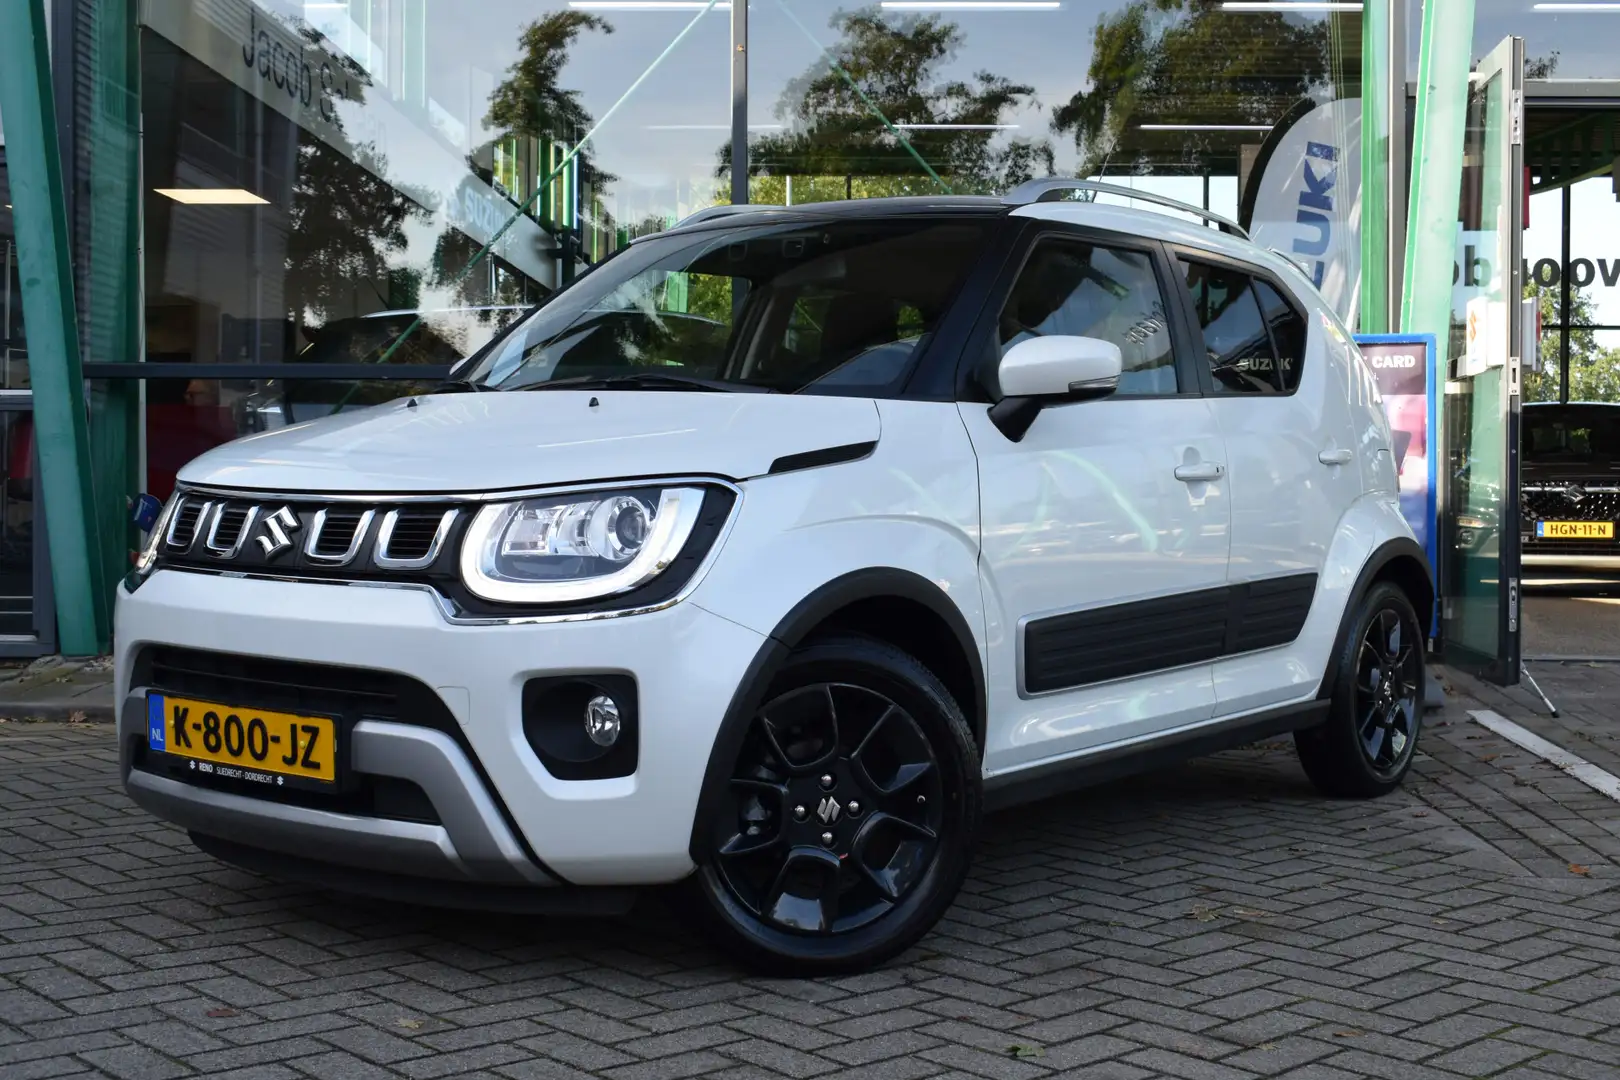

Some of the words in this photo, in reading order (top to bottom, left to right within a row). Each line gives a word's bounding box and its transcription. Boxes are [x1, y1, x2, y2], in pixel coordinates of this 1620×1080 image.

[243, 6, 311, 107] Jacob
[1372, 355, 1416, 368] CARD
[1550, 524, 1606, 535] HGN-11-N
[151, 727, 164, 742] NL
[173, 705, 321, 770] K-800-JZ
[199, 762, 214, 773] RENO
